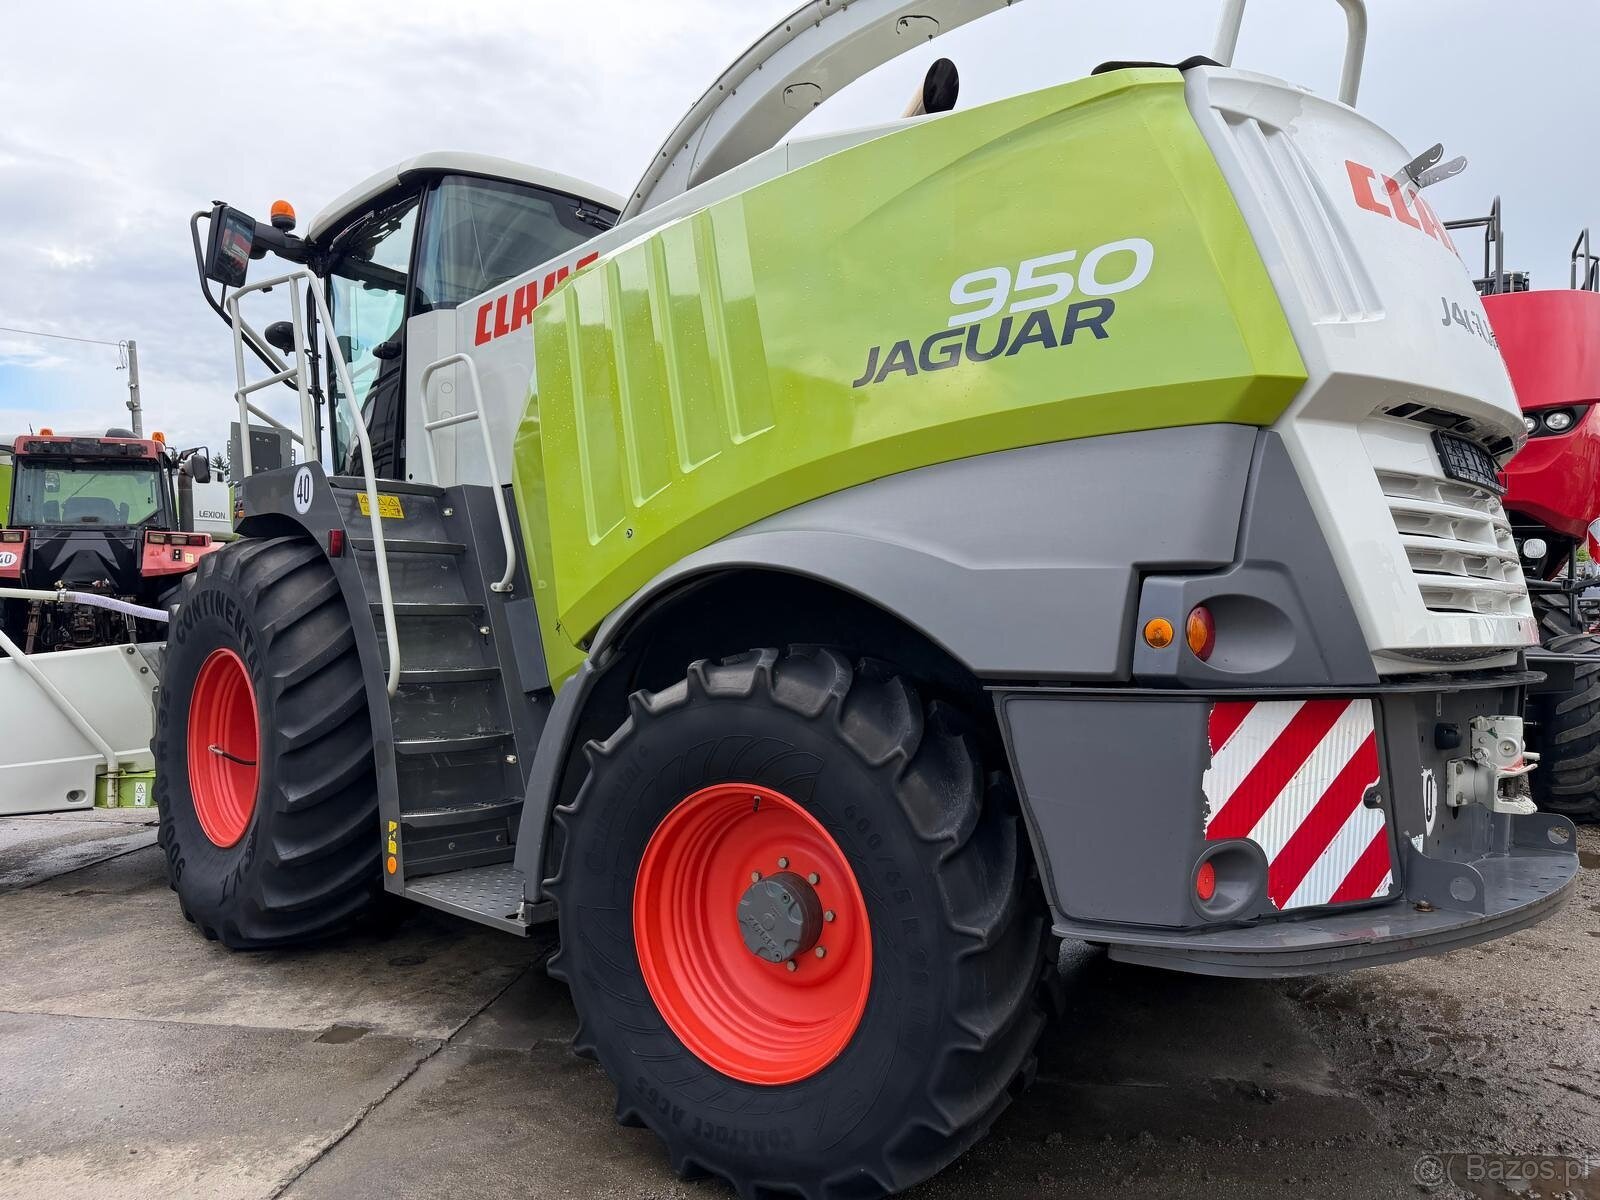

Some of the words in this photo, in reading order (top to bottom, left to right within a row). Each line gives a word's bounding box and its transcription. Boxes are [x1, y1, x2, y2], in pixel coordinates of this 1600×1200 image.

[947, 238, 1154, 327] 950
[852, 298, 1116, 388] JAGUAR
[198, 510, 226, 519] LEXION
[296, 474, 310, 504] 40
[176, 590, 264, 685] CONTINENTAL
